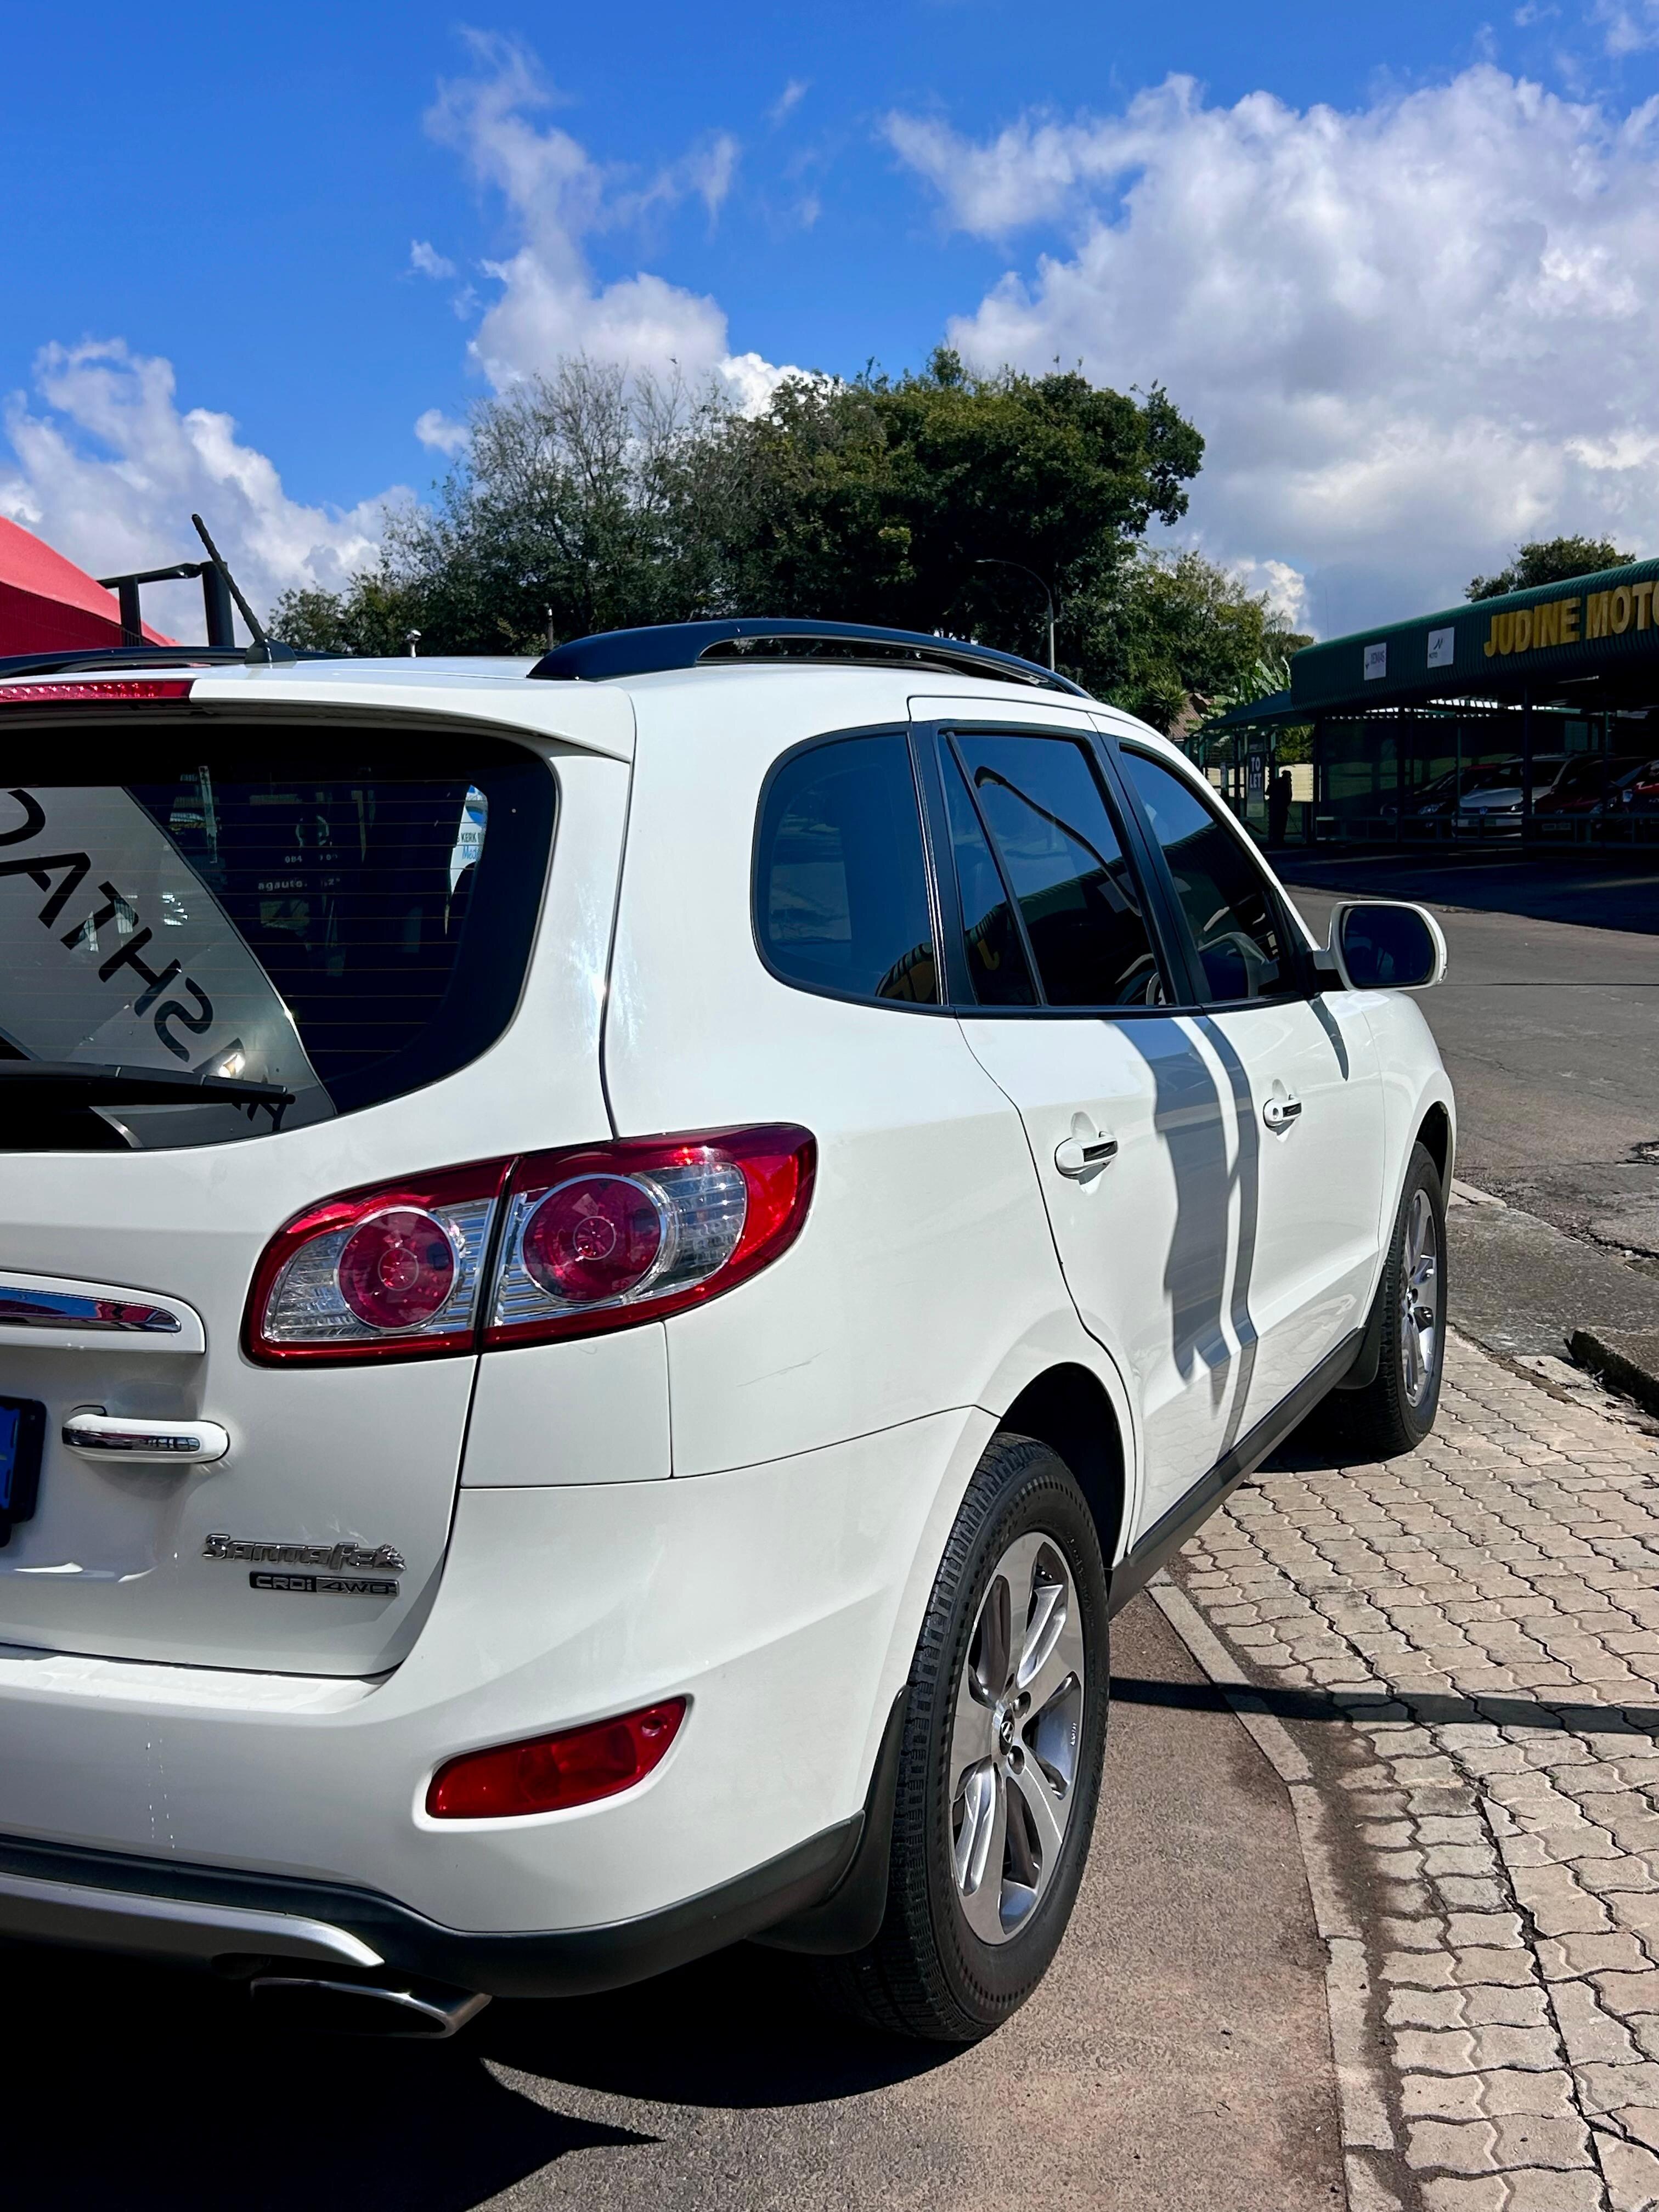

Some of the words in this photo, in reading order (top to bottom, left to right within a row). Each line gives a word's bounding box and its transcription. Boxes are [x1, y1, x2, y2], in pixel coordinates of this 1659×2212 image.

[1483, 597, 1581, 657] JUDINE
[1251, 756, 1261, 772] TO
[1249, 772, 1262, 788] LET
[256, 1576, 312, 1591] CRDi
